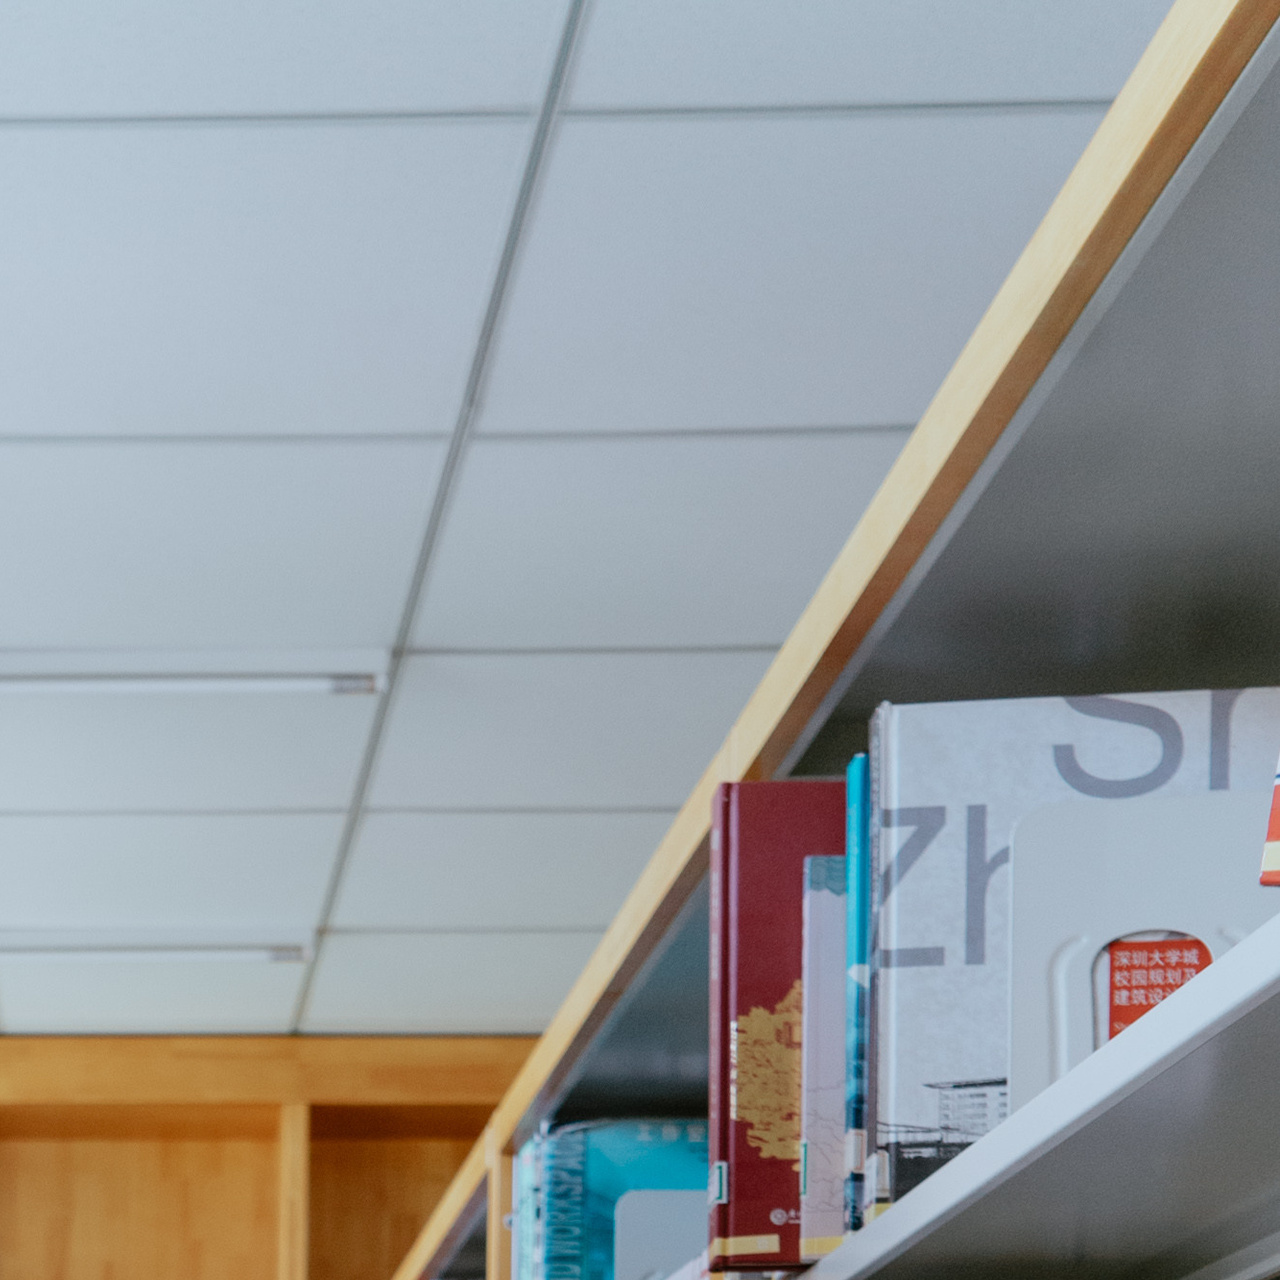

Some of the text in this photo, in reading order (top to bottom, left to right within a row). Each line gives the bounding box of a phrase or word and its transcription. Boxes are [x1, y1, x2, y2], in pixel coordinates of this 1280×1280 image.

[1113, 950, 1200, 967] 深圳大学城
